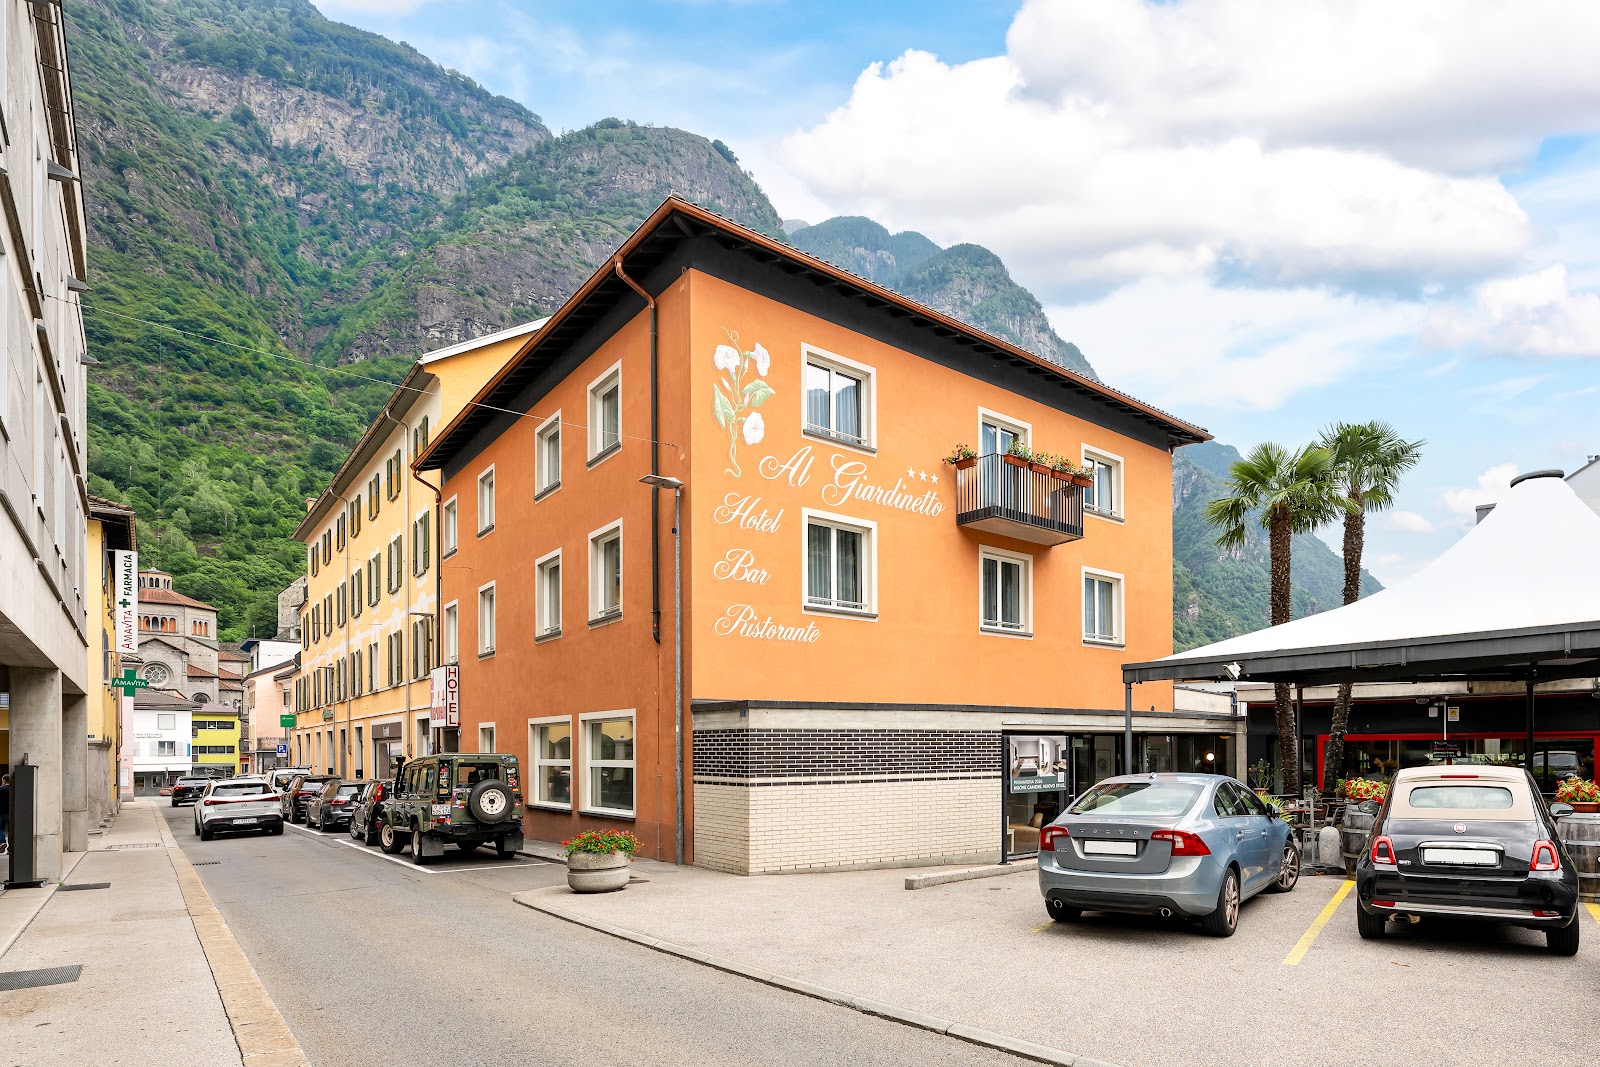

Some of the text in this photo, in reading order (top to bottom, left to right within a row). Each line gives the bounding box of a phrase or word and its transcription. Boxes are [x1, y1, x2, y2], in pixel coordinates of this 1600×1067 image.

[758, 445, 946, 517] Al Giardinetto
[713, 492, 784, 534] Hotel
[123, 554, 133, 597] FARMACIA
[713, 548, 771, 585] Bar
[714, 603, 821, 643] Ristorante
[447, 667, 458, 725] HOTEL
